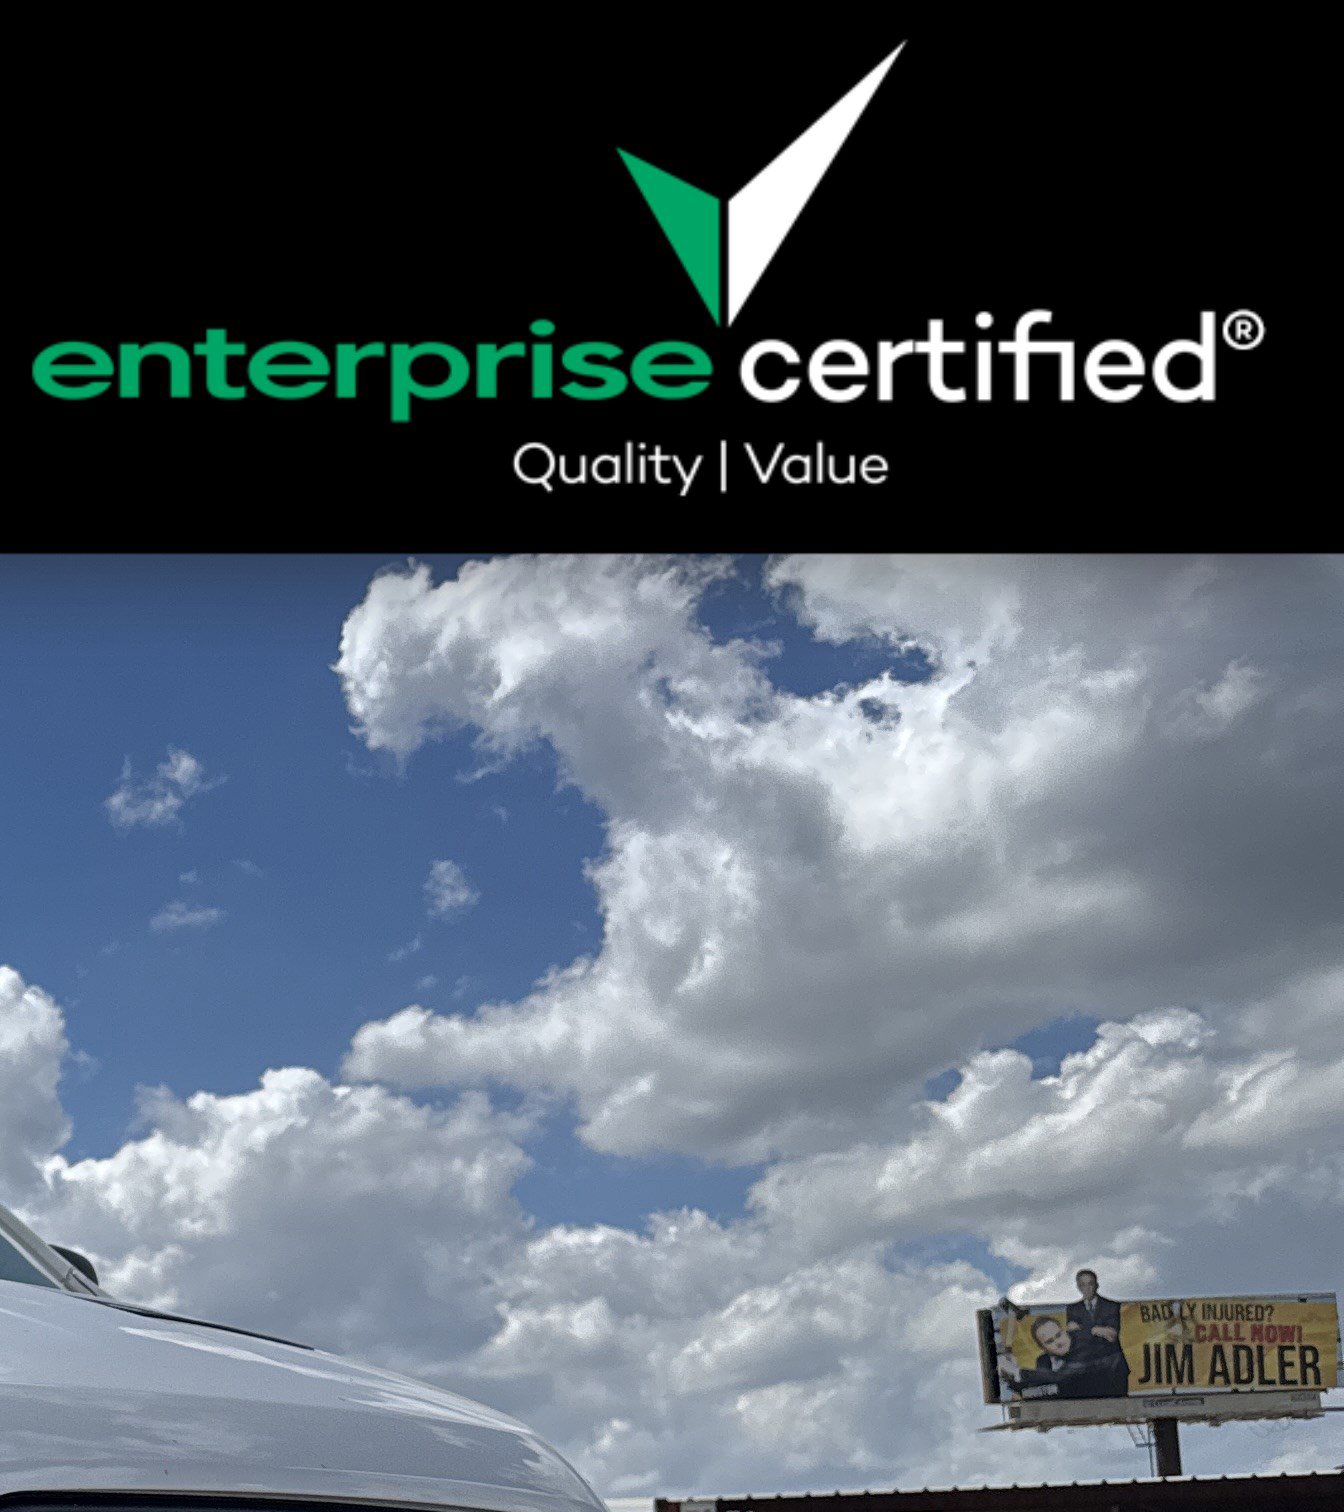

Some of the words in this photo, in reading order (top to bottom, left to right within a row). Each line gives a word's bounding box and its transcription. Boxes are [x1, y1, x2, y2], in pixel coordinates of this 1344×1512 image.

[1202, 1302, 1275, 1322] INJURED?
[1194, 1323, 1246, 1343] CALL
[1251, 1324, 1303, 1343] NOW!
[1138, 1343, 1194, 1385] JIM
[1209, 1344, 1321, 1386] ADLER
